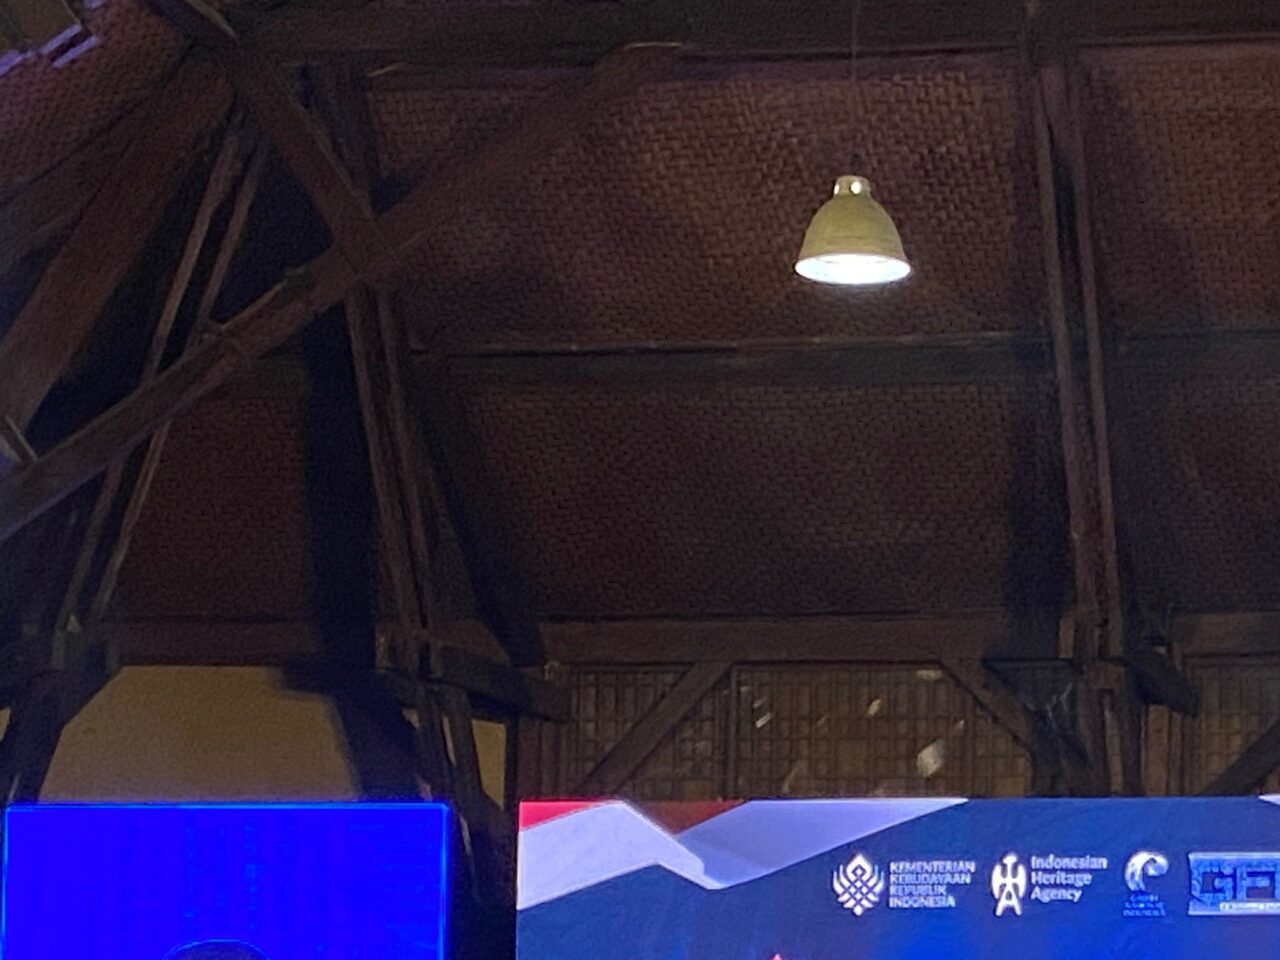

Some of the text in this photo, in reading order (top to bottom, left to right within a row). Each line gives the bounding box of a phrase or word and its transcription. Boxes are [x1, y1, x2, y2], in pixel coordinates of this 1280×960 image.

[889, 861, 975, 873] KEMENTERIAN
[1031, 855, 1108, 869] Indonesian
[889, 873, 971, 885] KEBUDAYAAN
[1031, 871, 1092, 886] Heritage
[1031, 886, 1082, 902] Agency
[888, 896, 955, 908] INDONESIA
